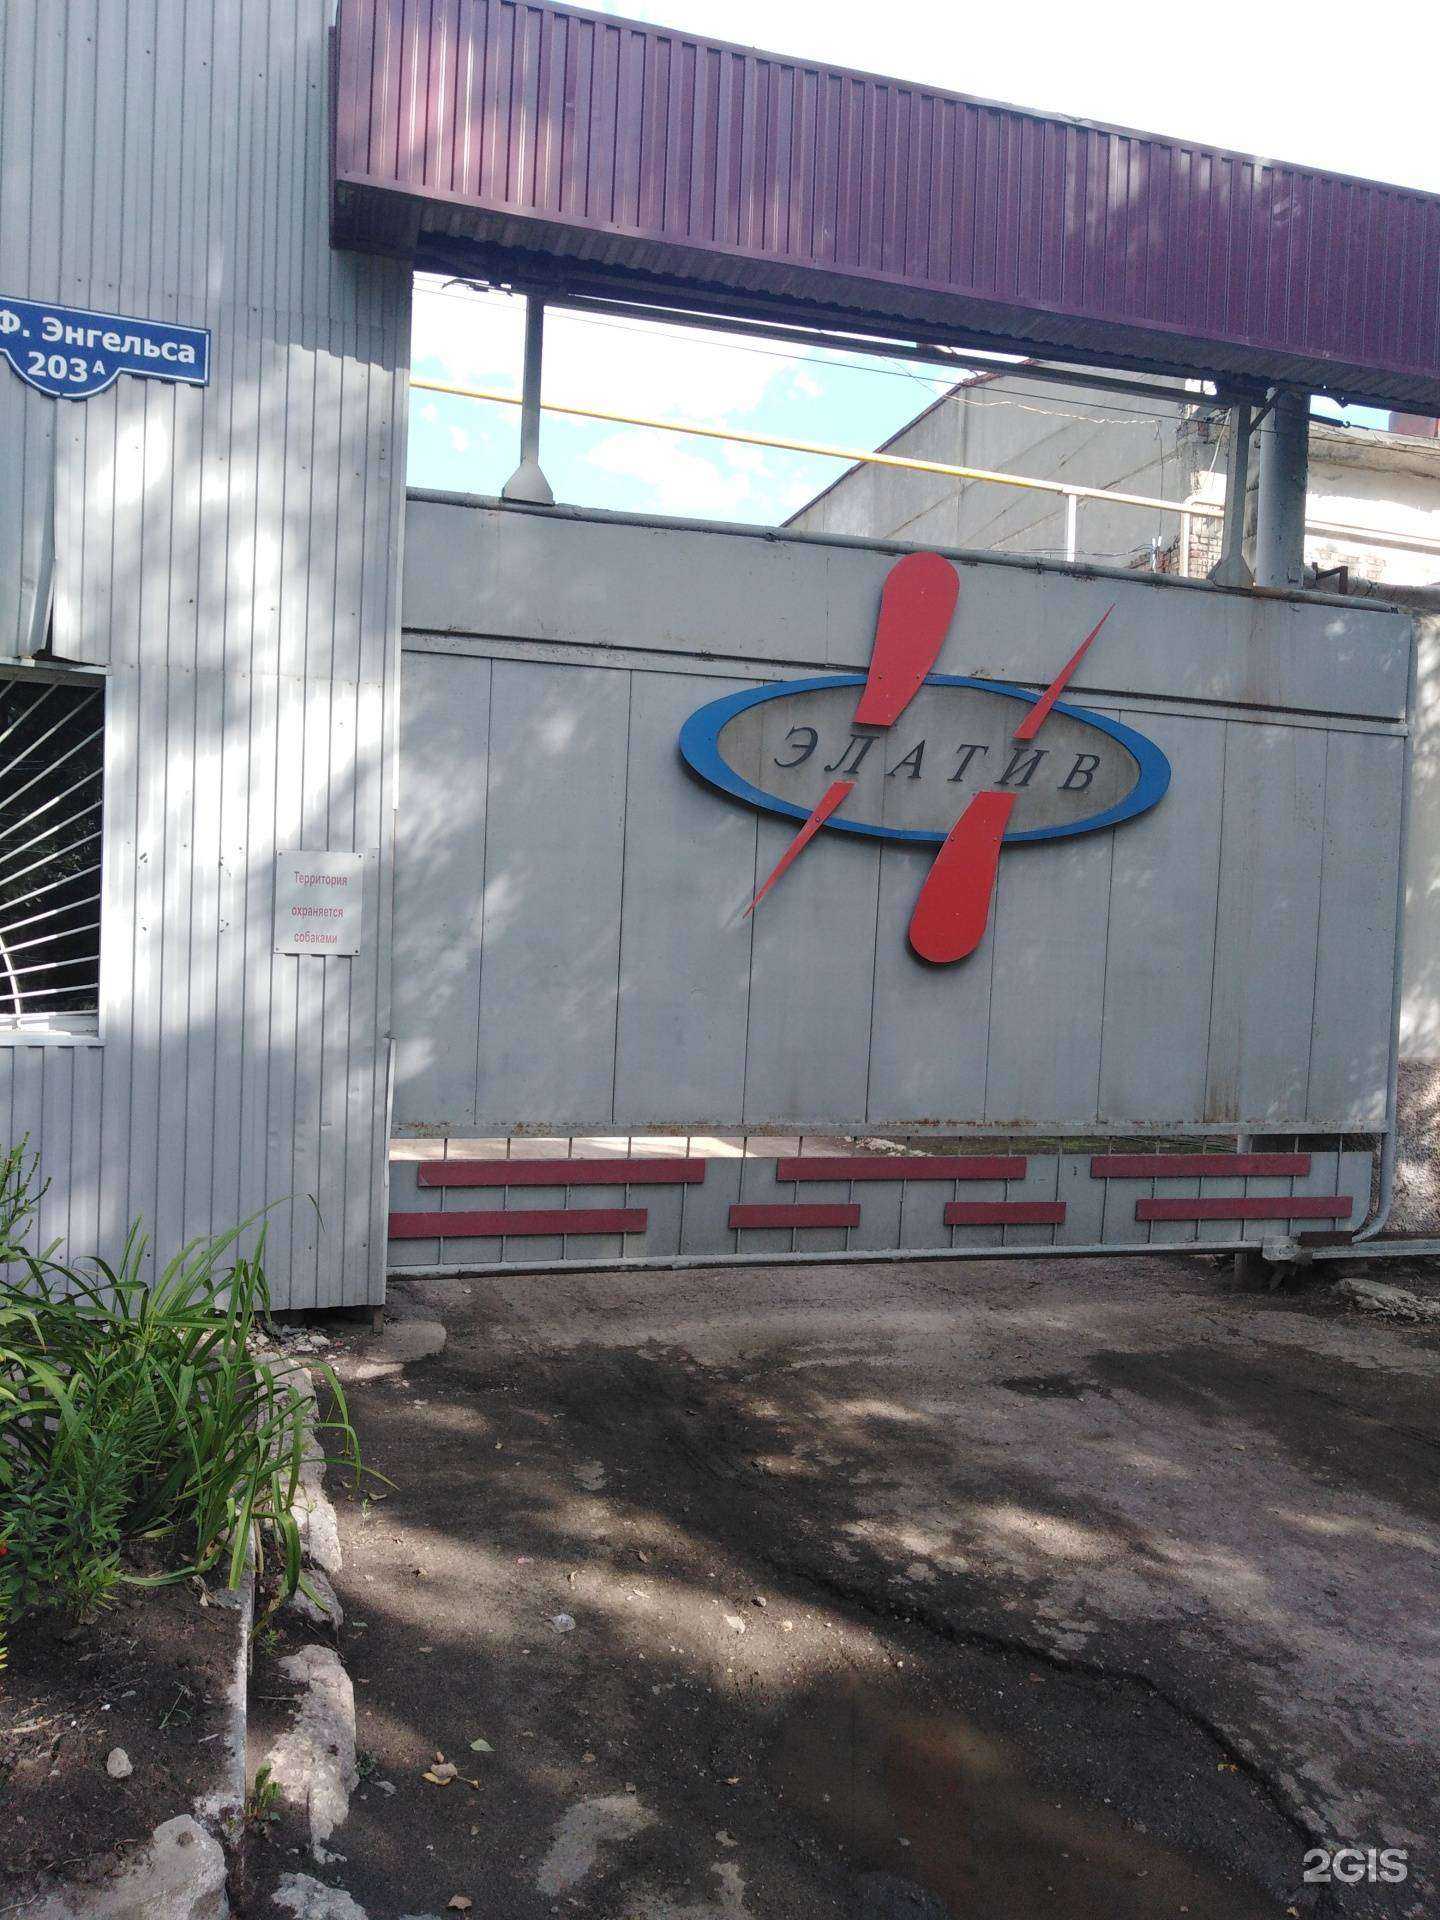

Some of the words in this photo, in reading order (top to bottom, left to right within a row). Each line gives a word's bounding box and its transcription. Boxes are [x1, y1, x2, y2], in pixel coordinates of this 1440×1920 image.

[0, 309, 30, 338] Ф.
[41, 316, 196, 365] Энгельса
[773, 725, 1102, 792] ЭЛАТИВ
[293, 871, 348, 887] Территория
[291, 906, 344, 919] охраняется
[293, 930, 338, 944] собаками
